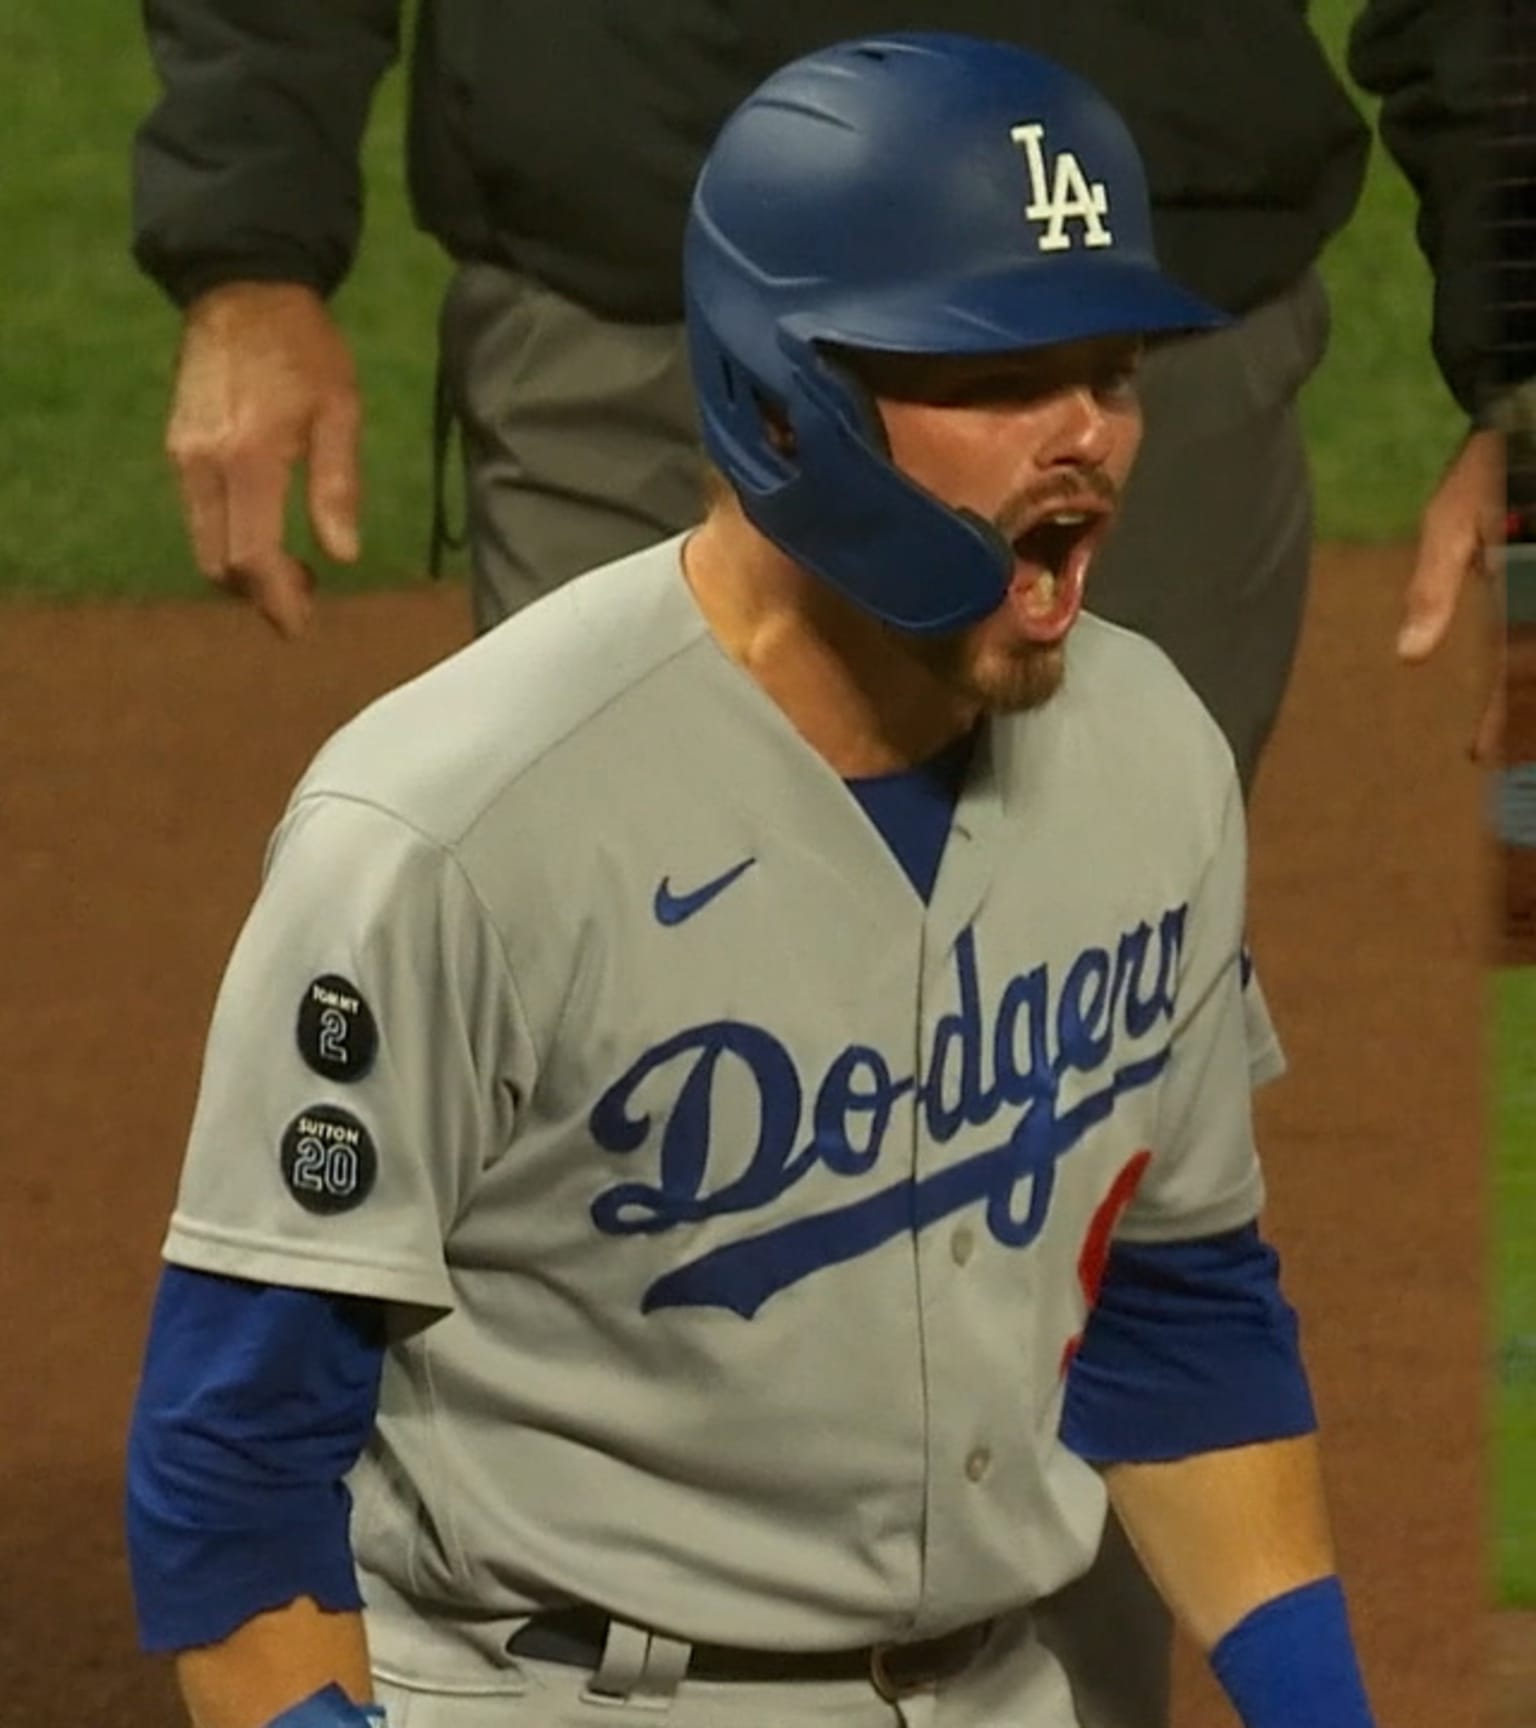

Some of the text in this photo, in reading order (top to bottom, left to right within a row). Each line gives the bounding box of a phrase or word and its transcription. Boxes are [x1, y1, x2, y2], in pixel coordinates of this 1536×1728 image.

[1010, 124, 1112, 250] LA
[313, 983, 360, 1015] TOMMY
[320, 1008, 348, 1064] 2
[298, 1117, 359, 1146] SUTTON
[293, 1137, 357, 1196] 20
